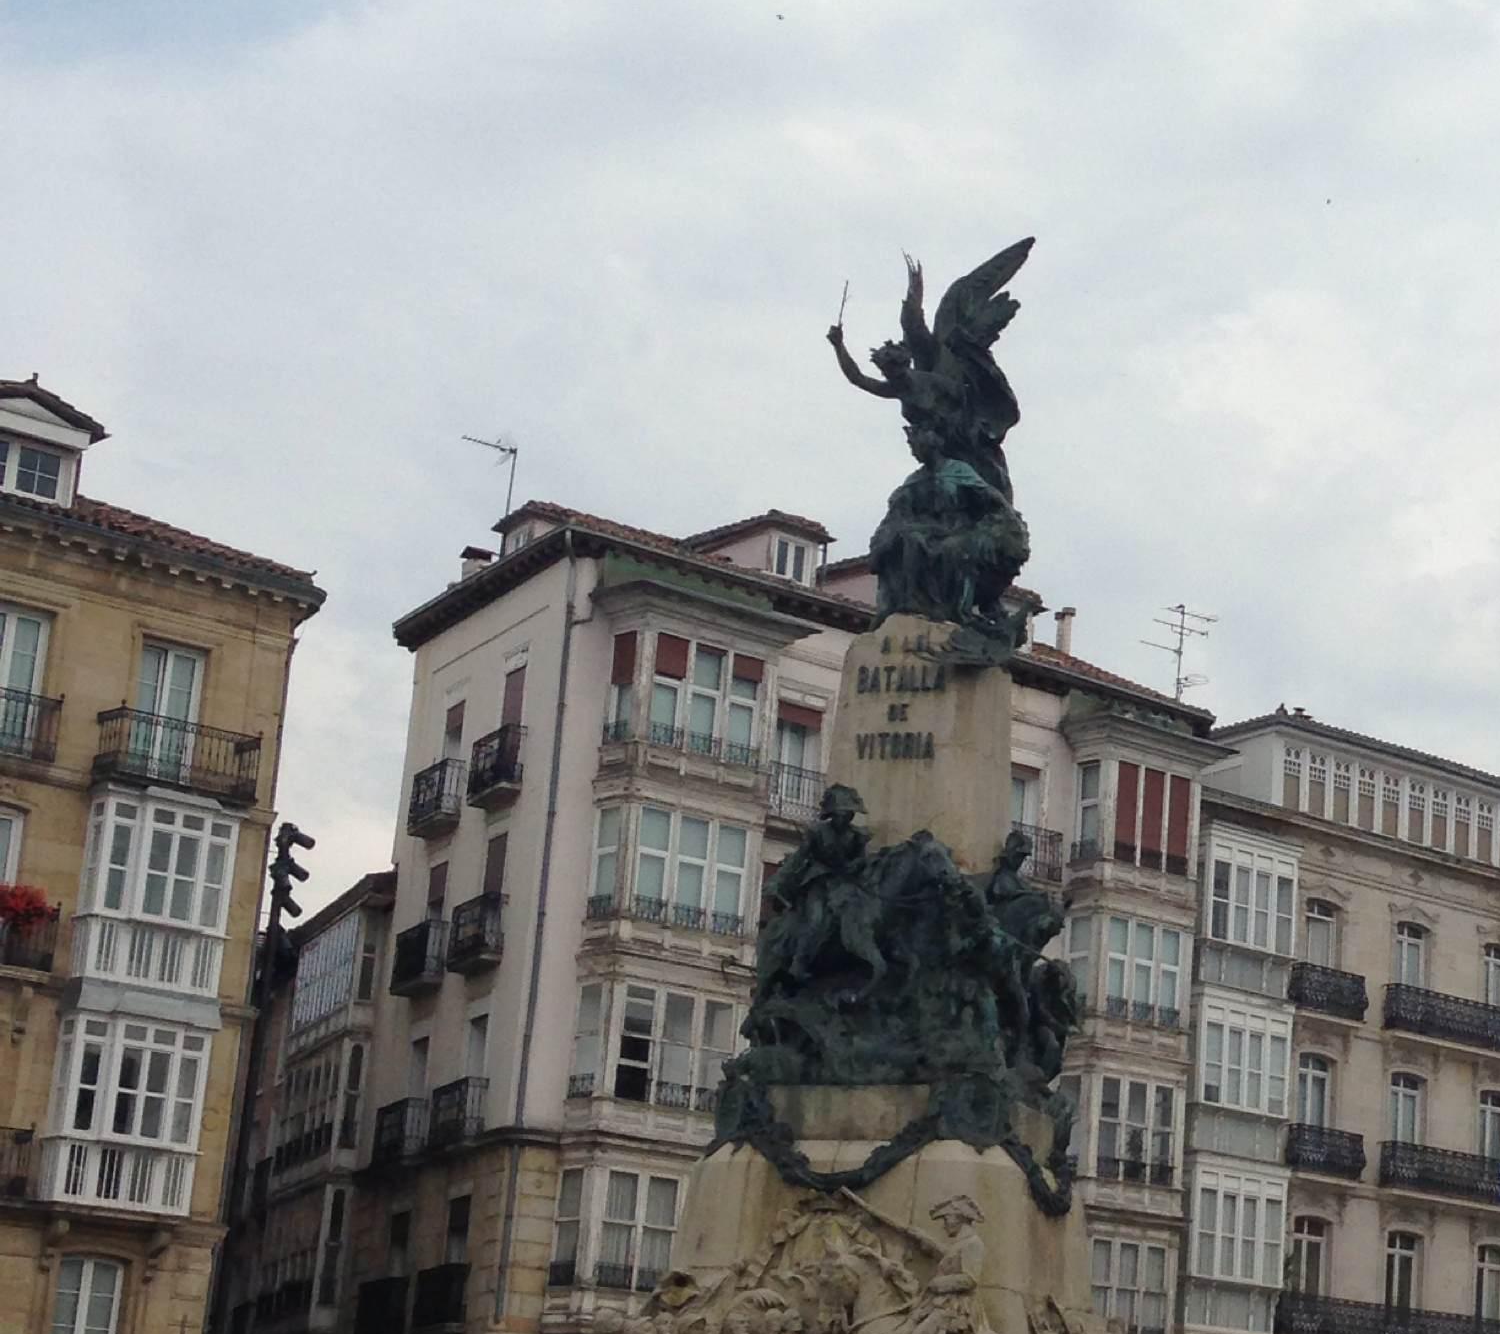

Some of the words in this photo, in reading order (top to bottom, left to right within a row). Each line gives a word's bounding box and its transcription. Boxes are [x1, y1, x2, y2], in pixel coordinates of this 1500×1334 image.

[857, 665, 946, 694] BATALLA
[888, 703, 909, 722] DE
[856, 732, 935, 761] VITORIA
